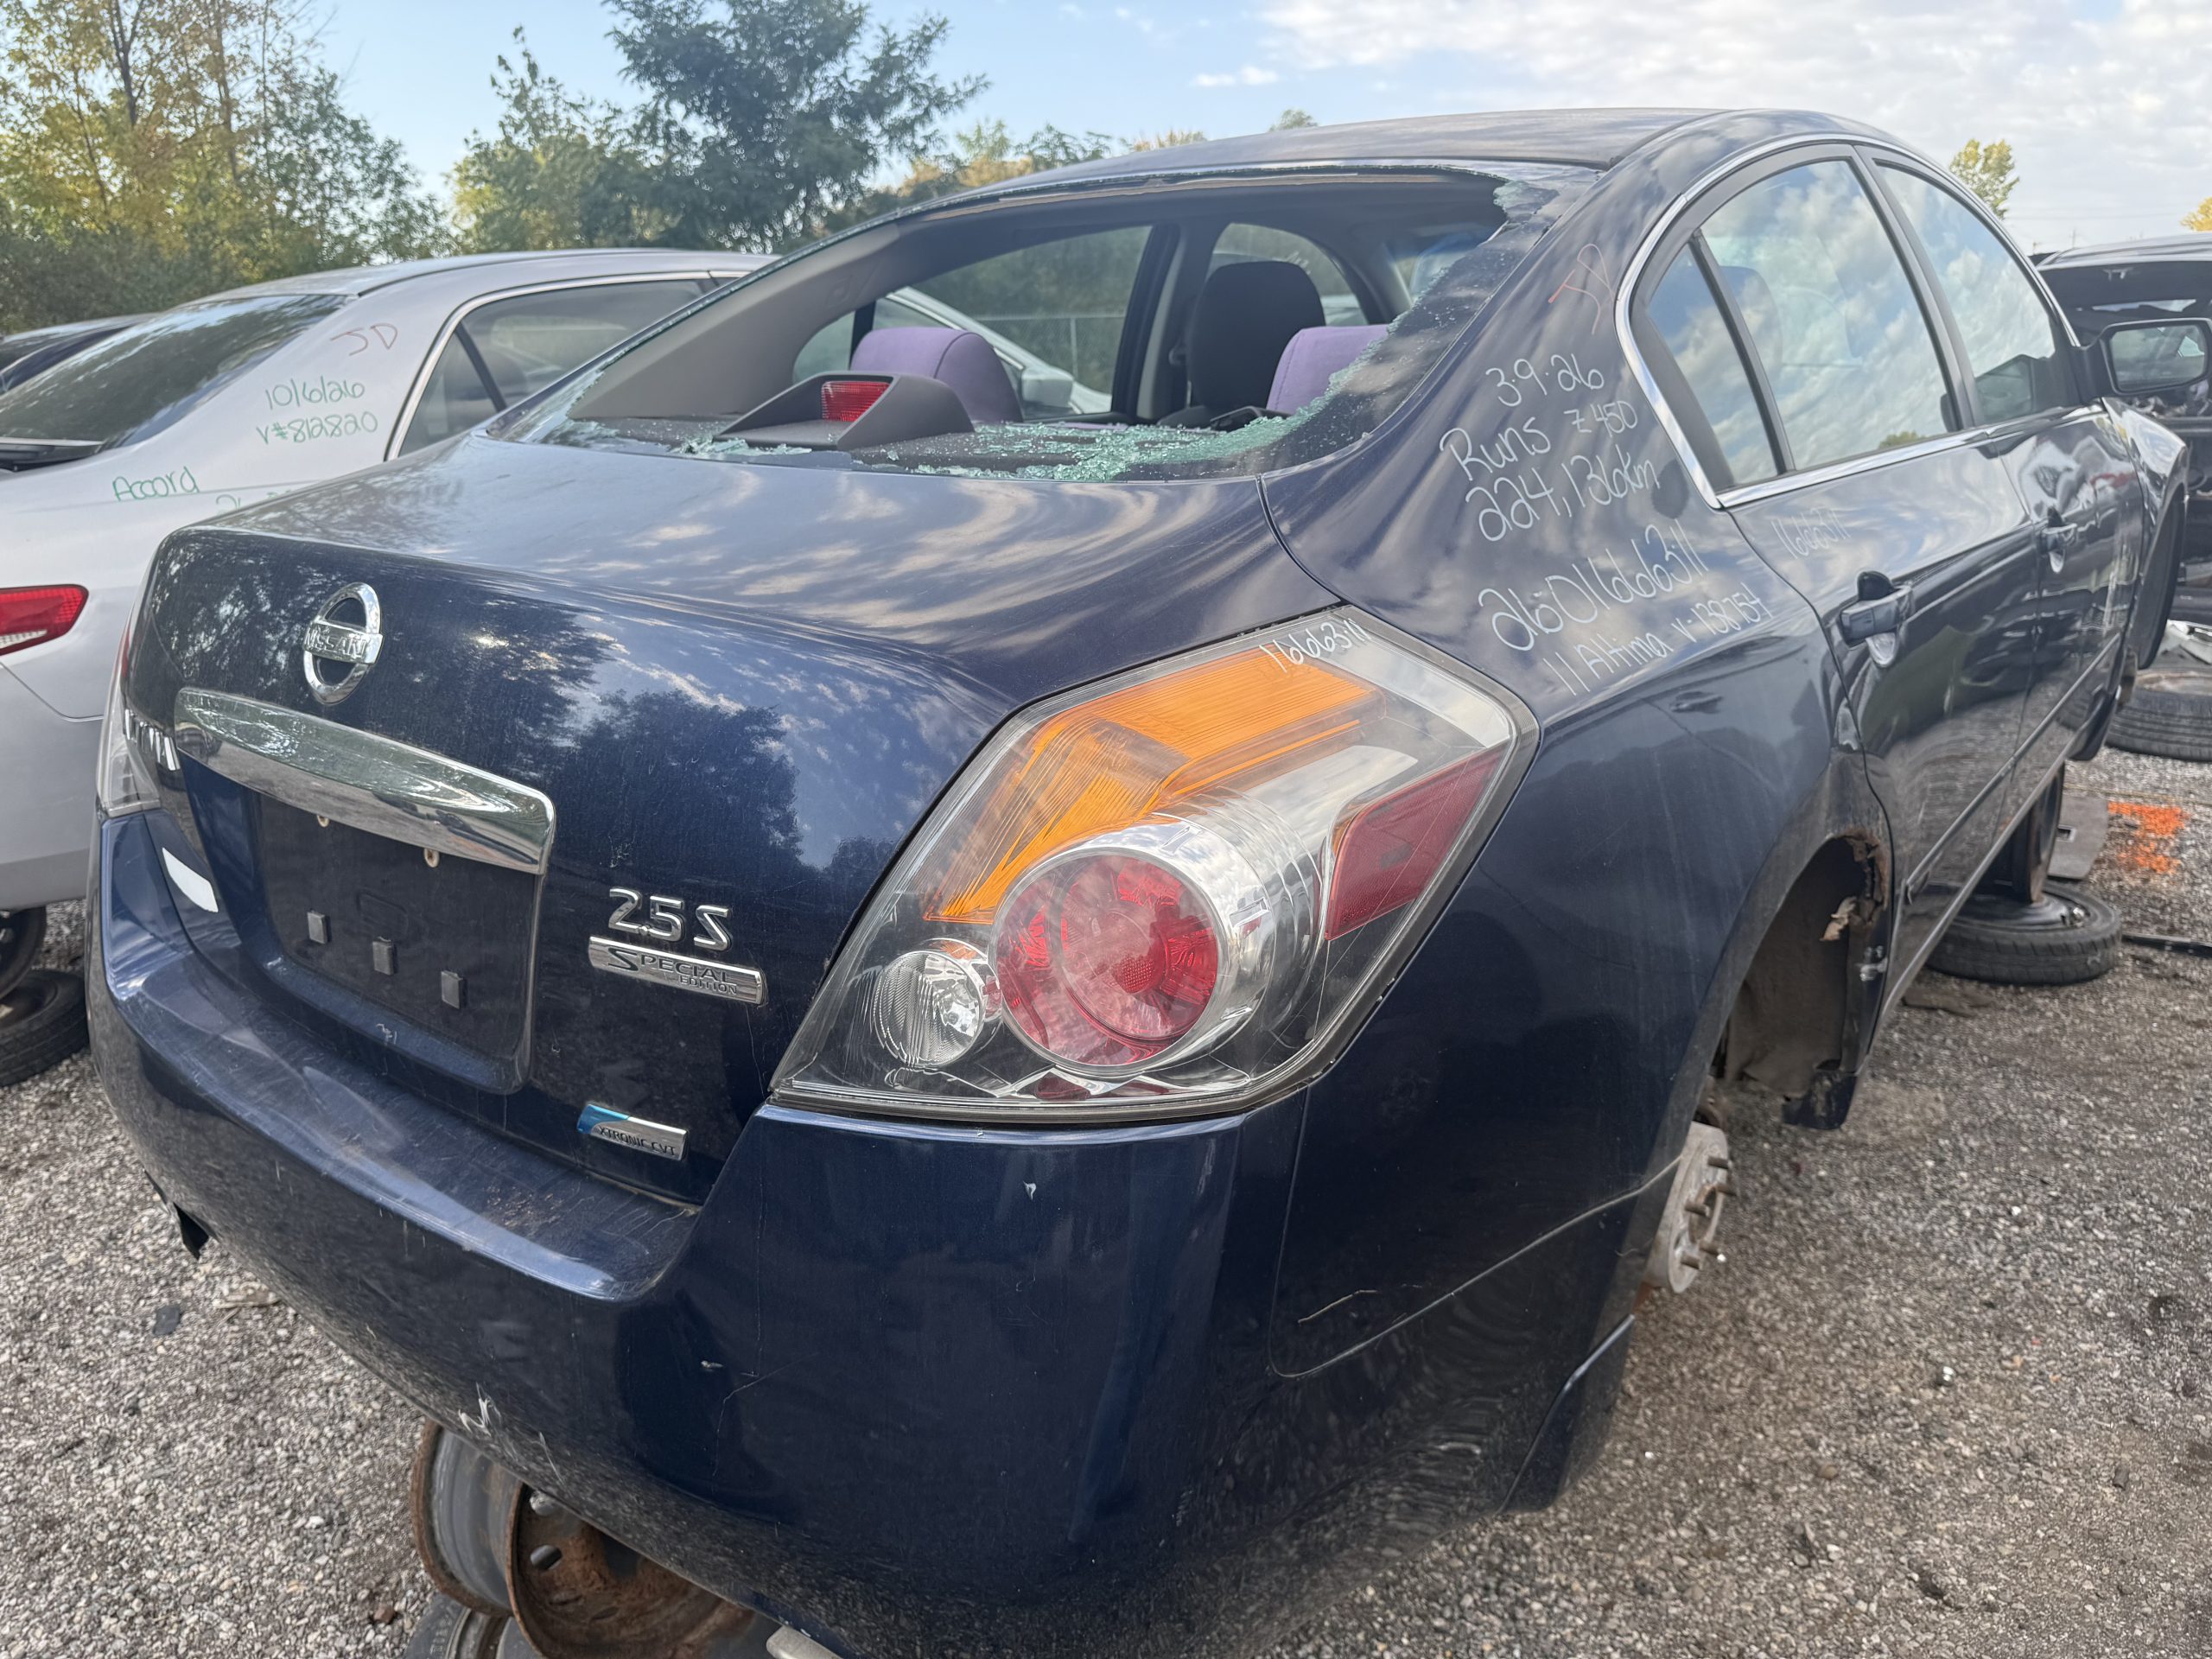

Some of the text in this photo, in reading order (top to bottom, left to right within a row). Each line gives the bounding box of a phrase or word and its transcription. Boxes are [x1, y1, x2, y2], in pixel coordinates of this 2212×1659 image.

[265, 375, 365, 410] 10/6/26
[1440, 416, 1551, 481] Runs
[111, 466, 200, 502] Accord
[304, 626, 368, 660] NISSAN
[1575, 633, 1674, 680] Altima
[608, 887, 731, 951] 2.5 S
[607, 947, 737, 986] SPECIAL
[679, 974, 737, 995] EDITION
[598, 1125, 677, 1156] XTRONIC CVT
